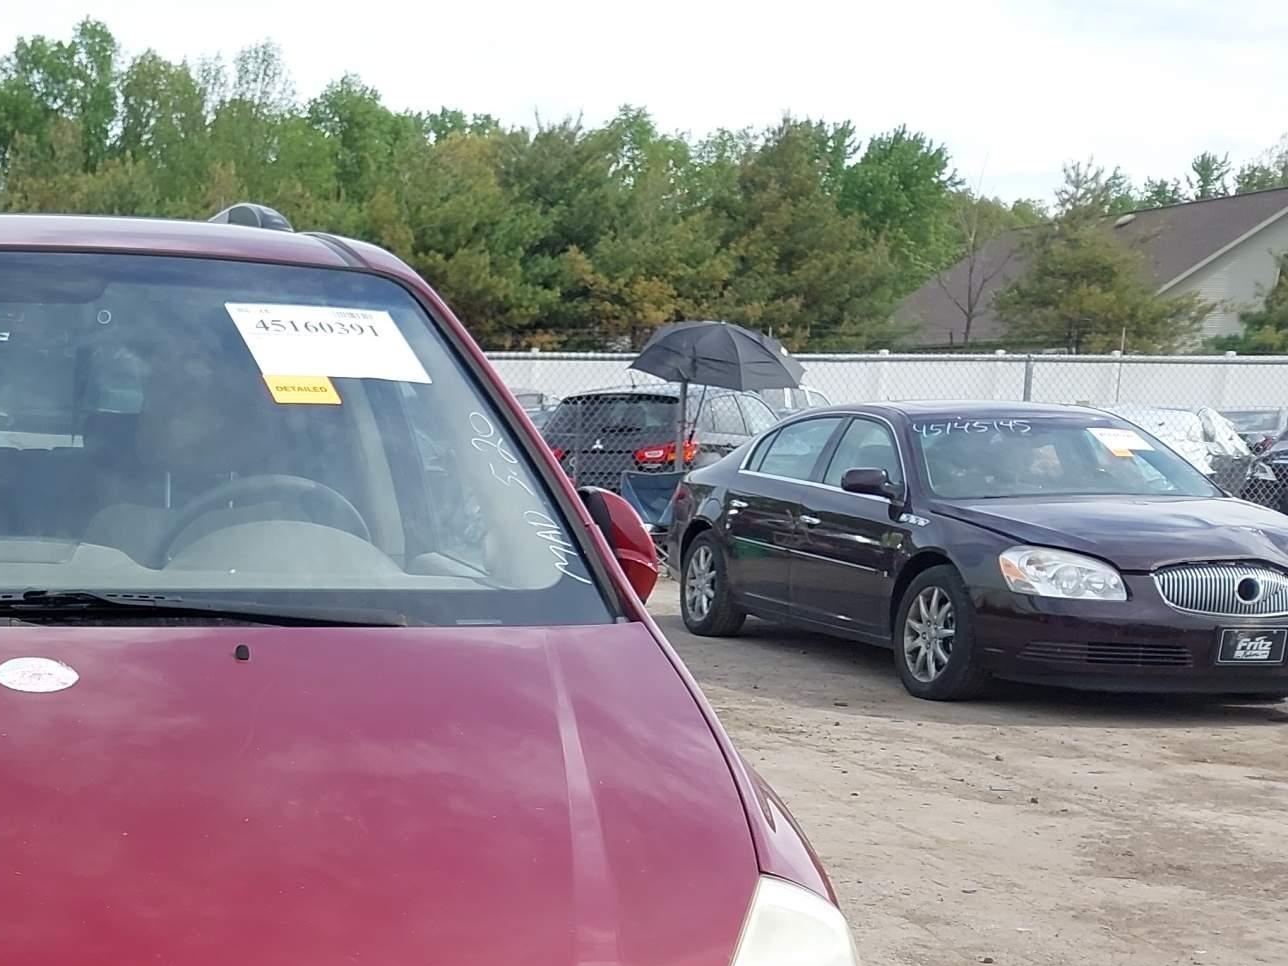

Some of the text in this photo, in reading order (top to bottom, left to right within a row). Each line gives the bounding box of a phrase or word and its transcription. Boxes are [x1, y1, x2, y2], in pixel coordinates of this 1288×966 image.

[254, 318, 381, 337] 45160391
[274, 384, 328, 394] DETAILED
[912, 419, 1033, 437] 45145145
[1236, 636, 1273, 650] Fritz
